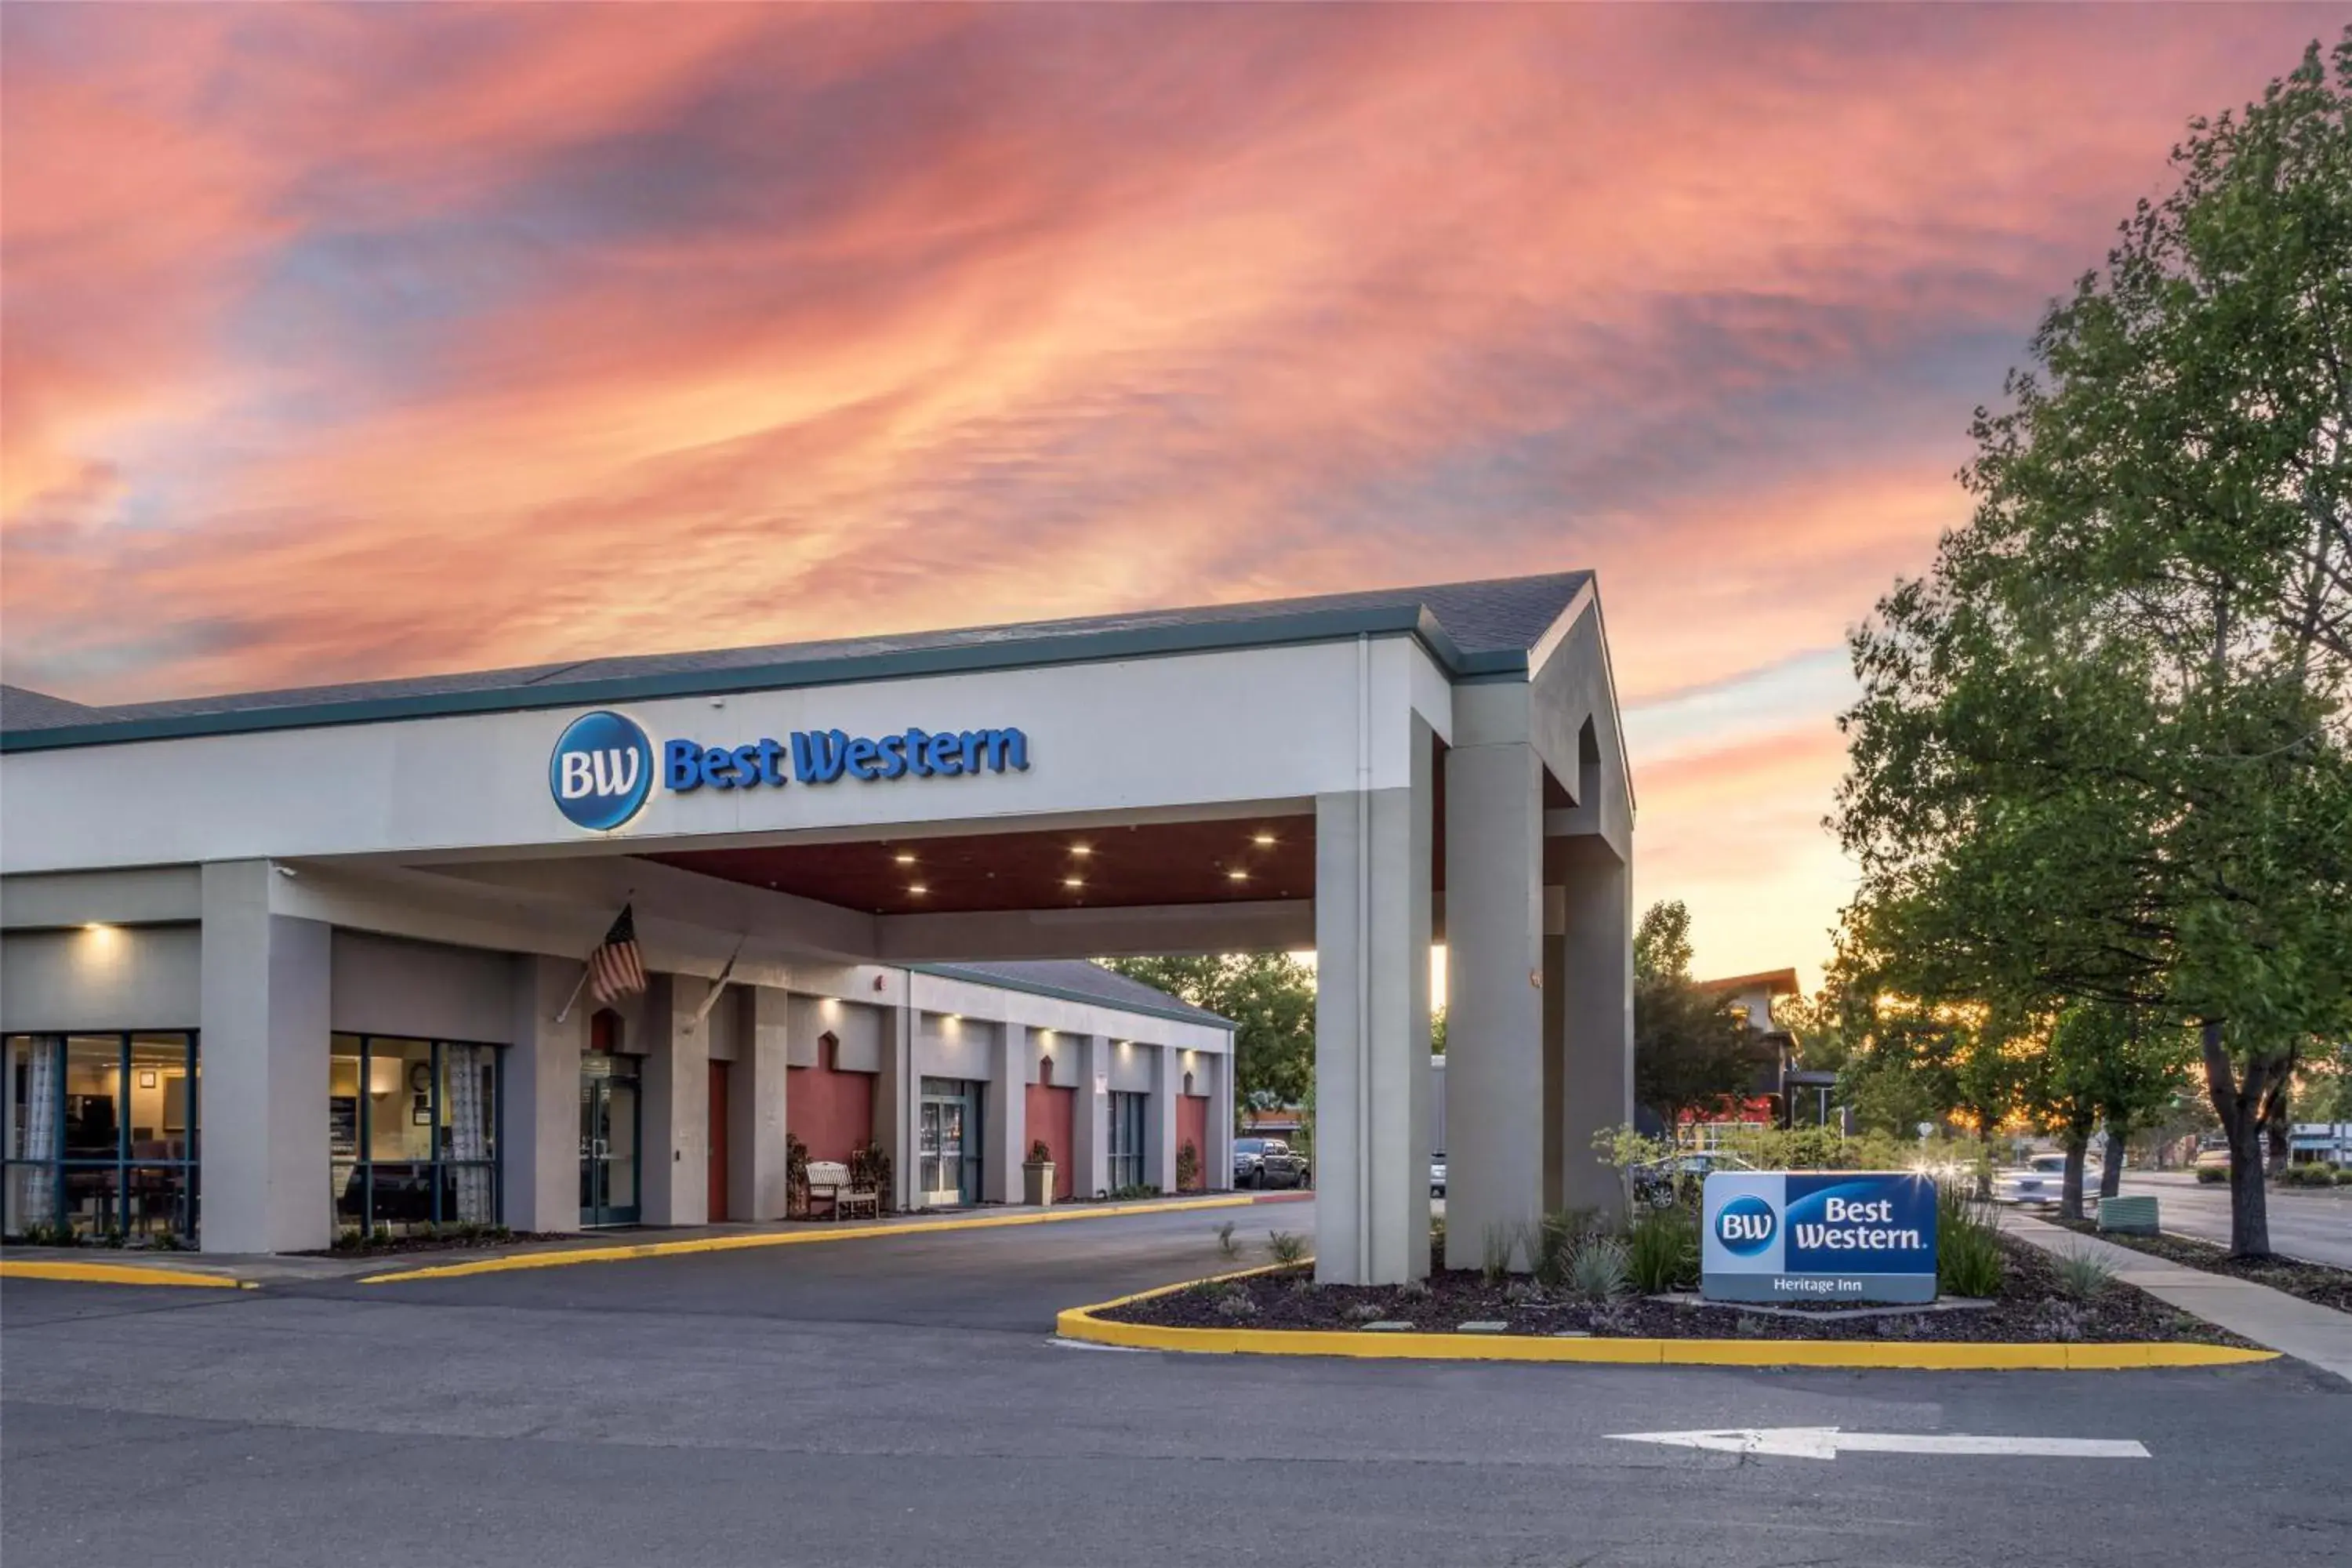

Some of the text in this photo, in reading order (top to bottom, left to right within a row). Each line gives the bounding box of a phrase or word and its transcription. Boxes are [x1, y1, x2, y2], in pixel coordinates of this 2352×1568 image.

[561, 727, 1029, 799] BW Best Western
[1826, 1198, 1893, 1222] Best
[1722, 1214, 1771, 1240] BW
[1774, 1279, 1862, 1294] Heritage Inn
